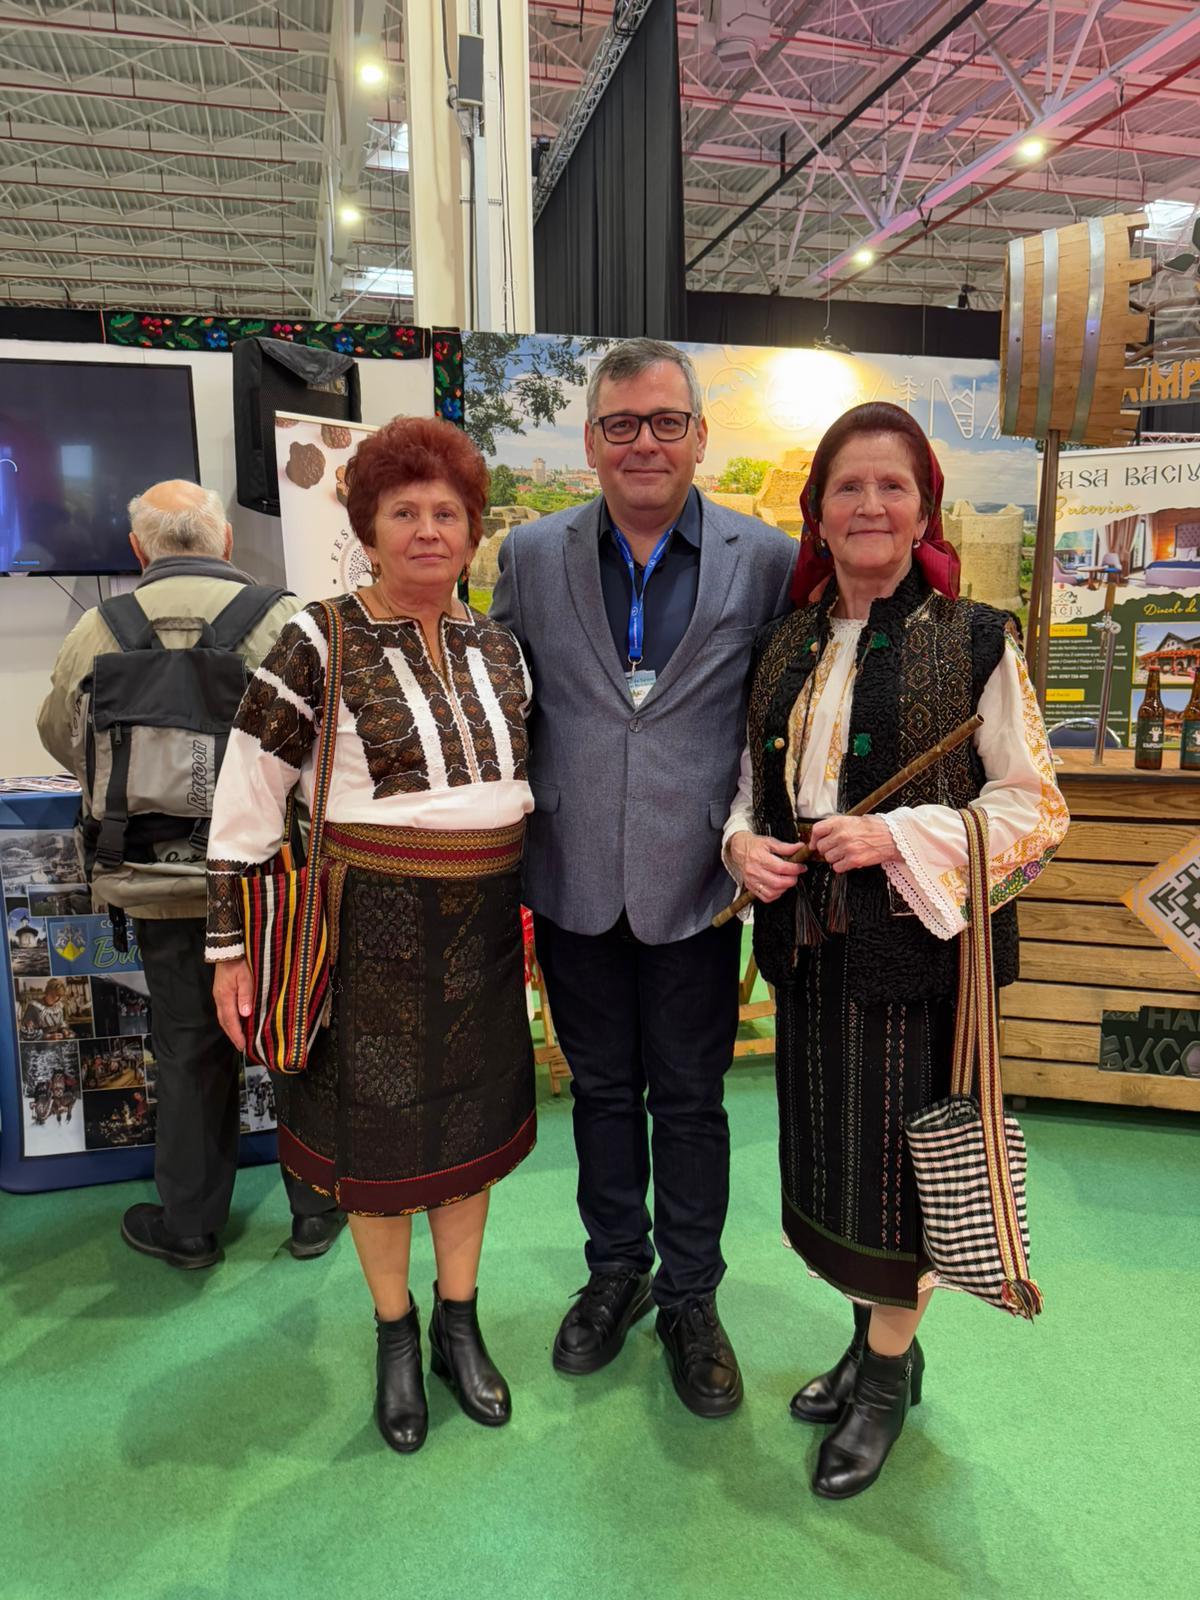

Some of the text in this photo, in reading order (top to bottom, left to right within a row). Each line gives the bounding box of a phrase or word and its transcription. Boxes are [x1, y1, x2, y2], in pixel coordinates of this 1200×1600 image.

[1058, 468, 1108, 489] ASA
[331, 528, 351, 562] FES
[187, 739, 207, 812] Racoon
[1147, 1008, 1200, 1032] HA
